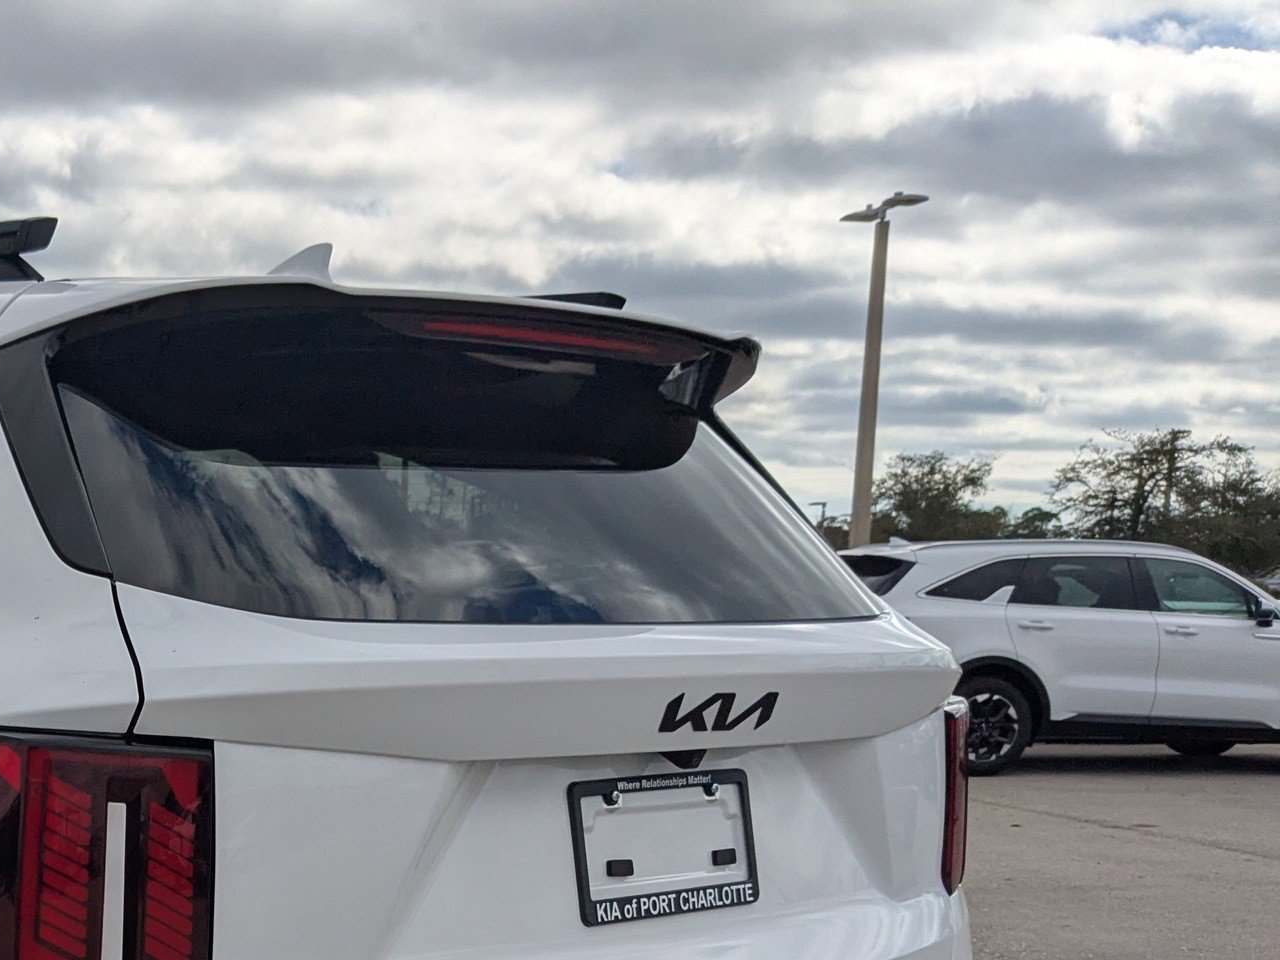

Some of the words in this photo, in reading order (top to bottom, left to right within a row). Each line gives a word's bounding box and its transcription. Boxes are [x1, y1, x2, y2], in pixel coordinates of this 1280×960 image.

[617, 781, 640, 791] Where
[641, 777, 687, 788] Relationships
[687, 774, 712, 784] Matter!
[596, 902, 622, 923] KIA
[624, 898, 638, 919] of
[640, 894, 677, 917] PORT
[679, 883, 754, 911] CHARLOTTE
